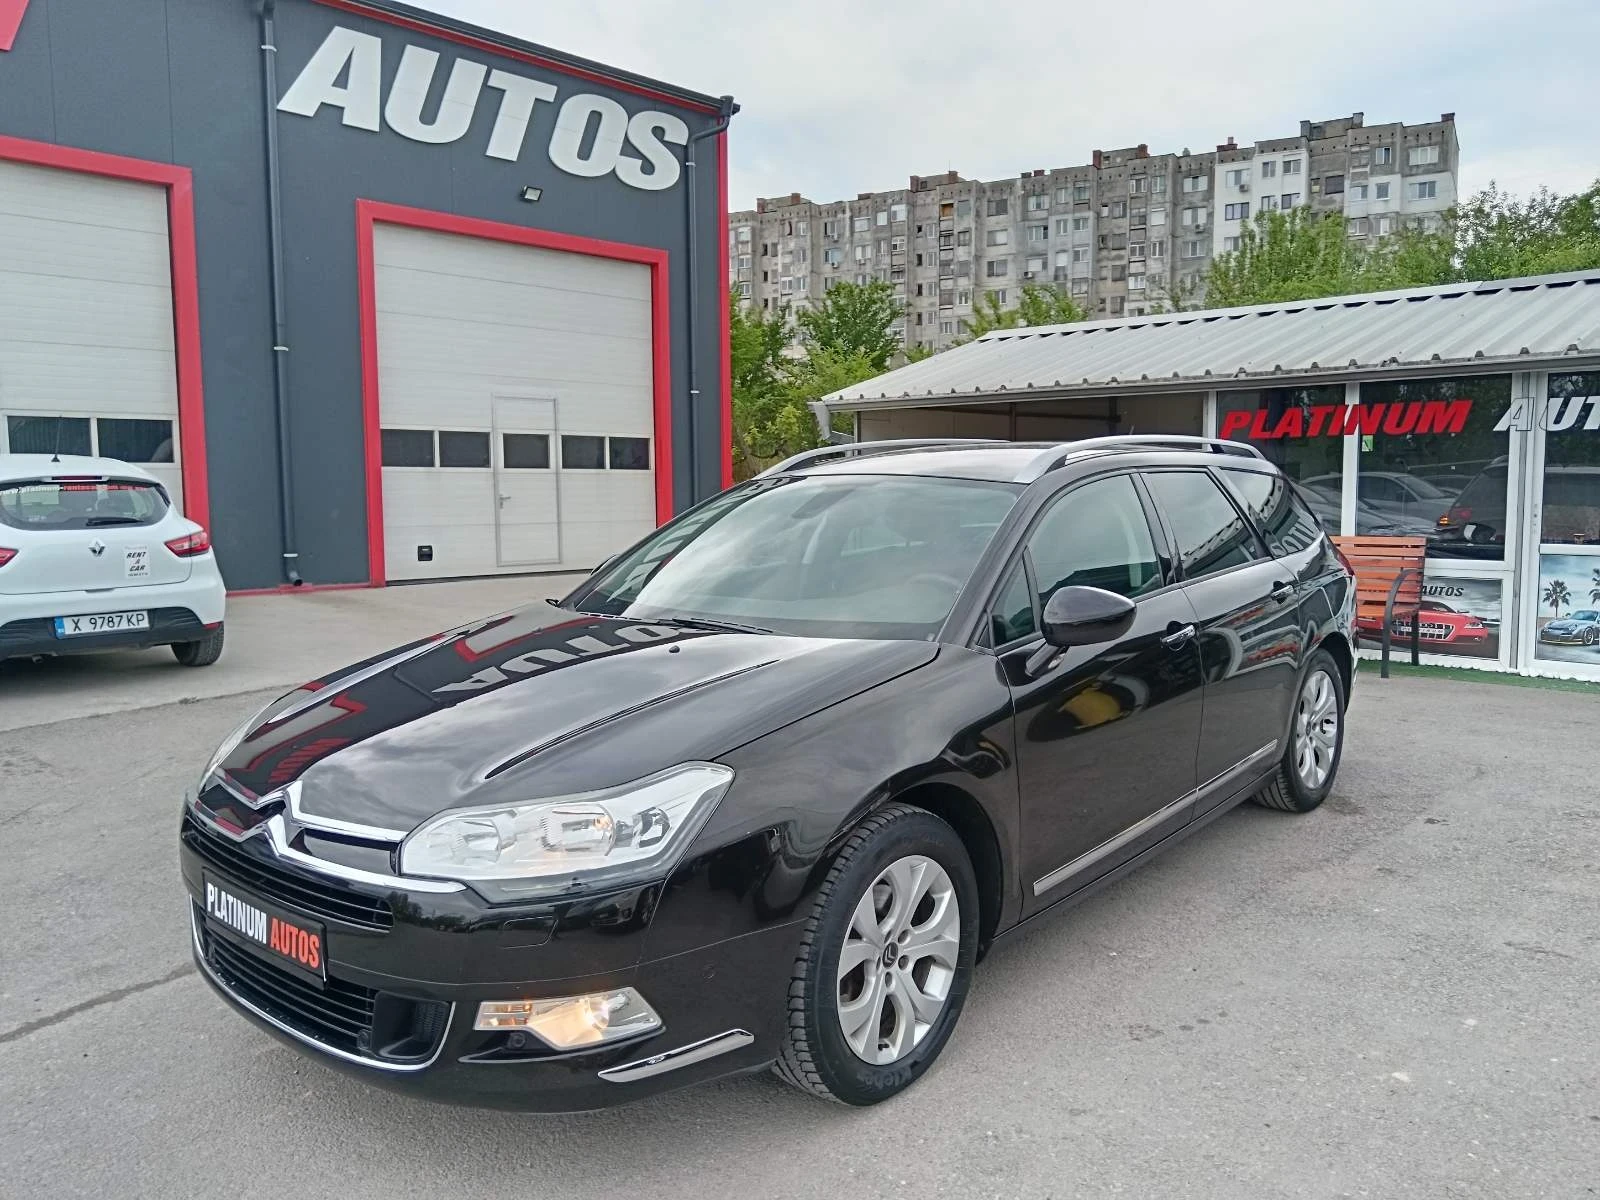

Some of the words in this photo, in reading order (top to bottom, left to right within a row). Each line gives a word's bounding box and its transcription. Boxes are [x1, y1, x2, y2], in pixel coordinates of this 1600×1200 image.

[276, 25, 689, 191] AUTOS
[1219, 399, 1474, 440] PLATINUM
[126, 551, 147, 559] RENT
[72, 618, 82, 632] X
[89, 615, 123, 630] 9787
[126, 613, 145, 627] KP
[207, 882, 267, 944] PLATINUM
[270, 917, 320, 968] AUTOS
